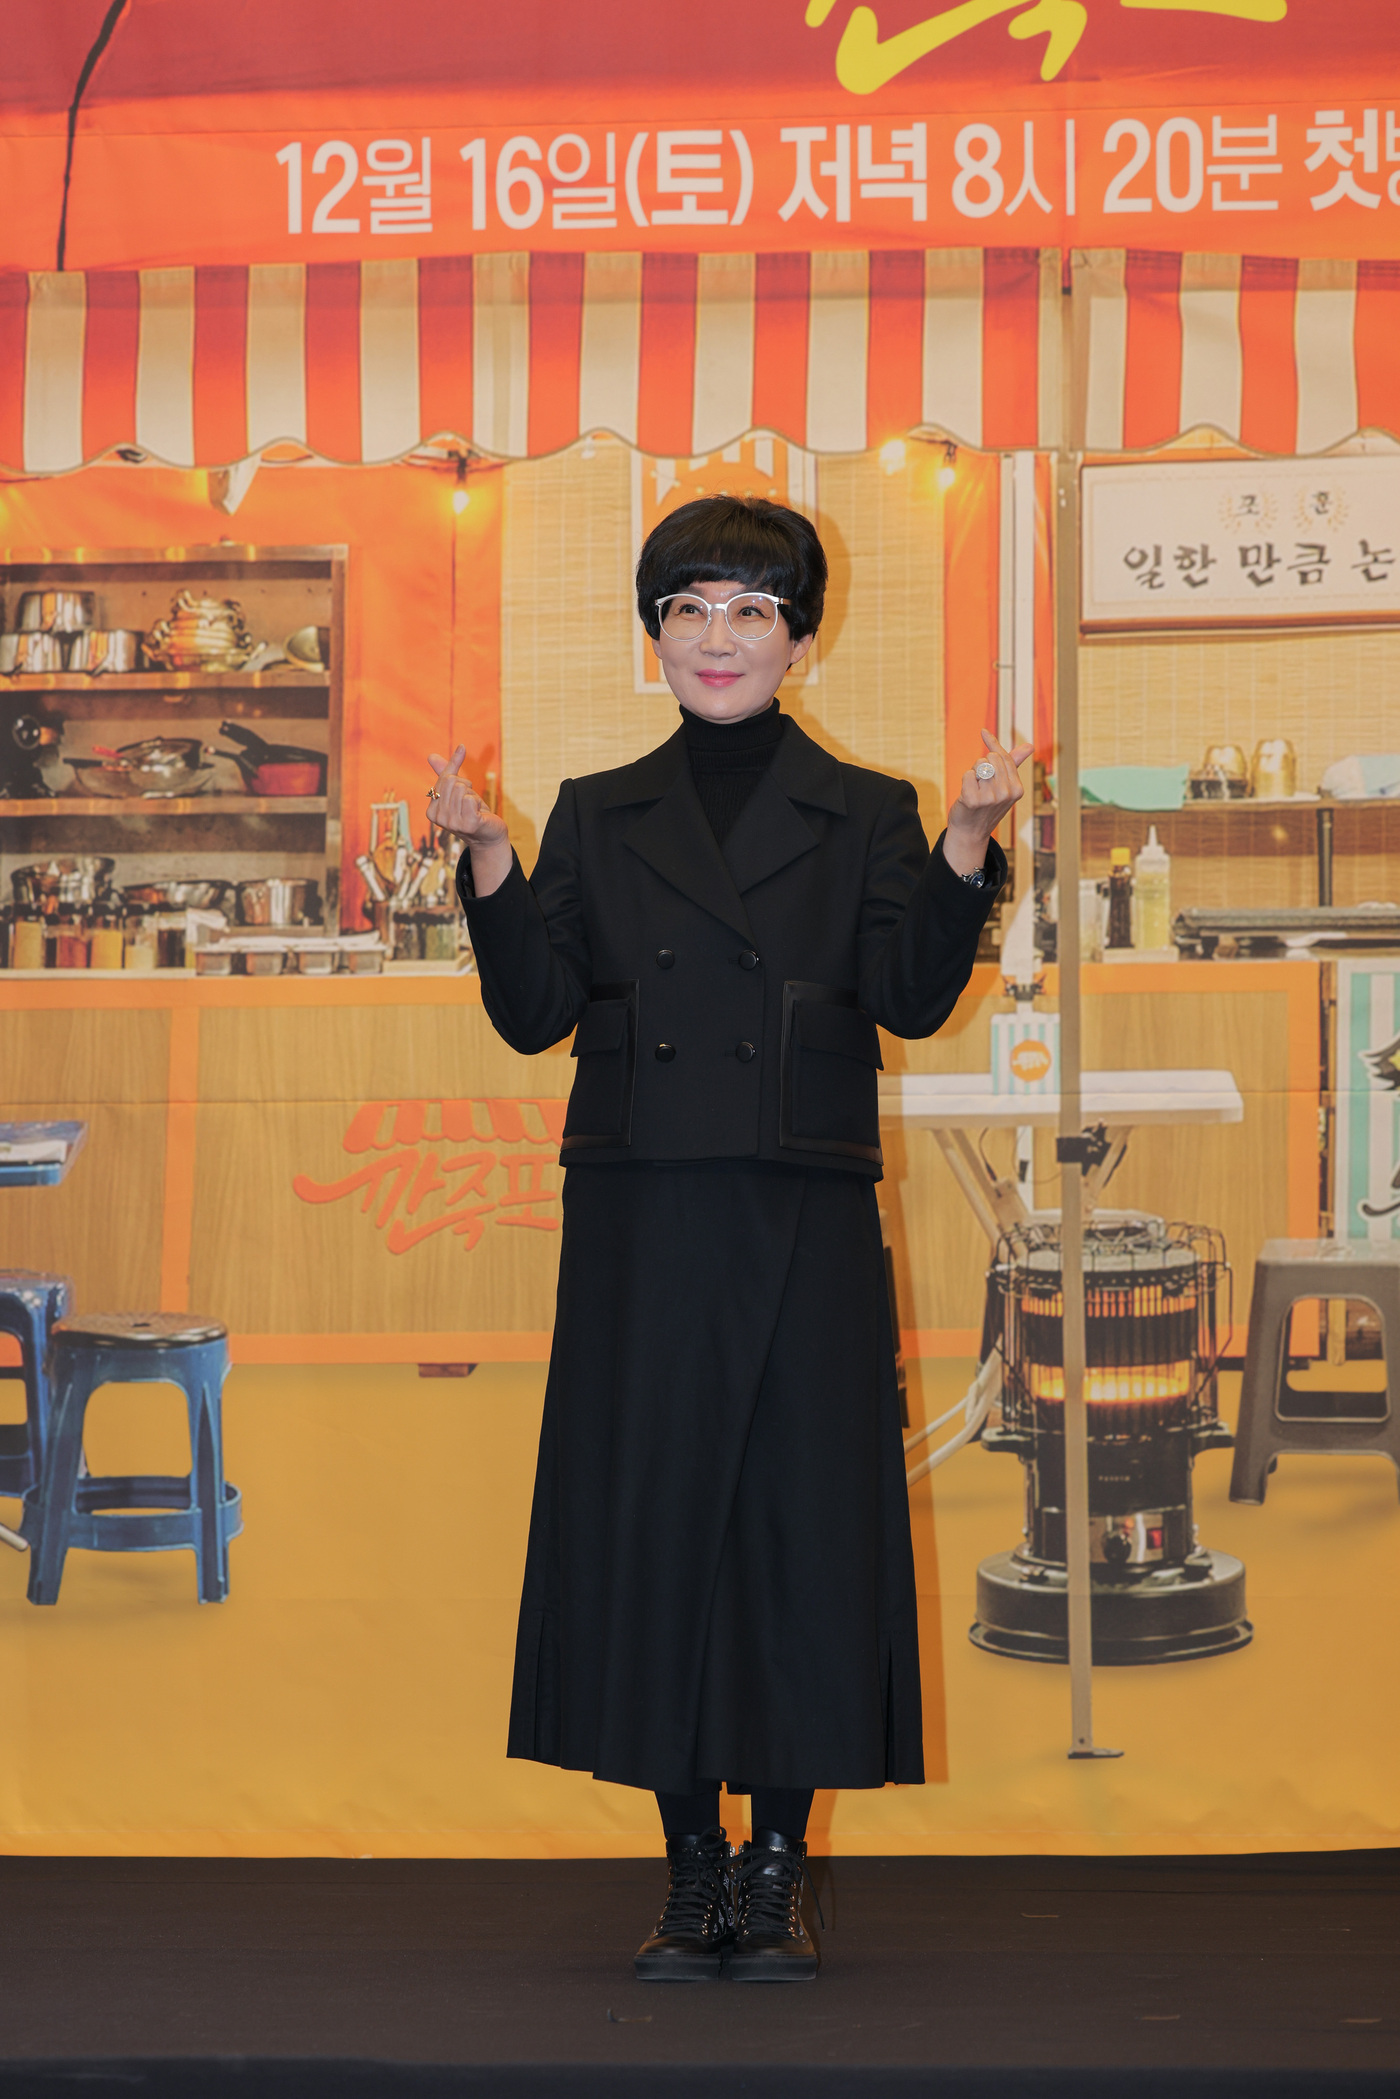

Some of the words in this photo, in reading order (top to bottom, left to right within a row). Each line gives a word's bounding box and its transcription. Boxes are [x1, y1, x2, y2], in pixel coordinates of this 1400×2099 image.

[275, 136, 433, 234] 12월
[778, 121, 928, 223] 저녁
[951, 118, 1077, 219] 8시
[1102, 113, 1283, 214] 20분
[1304, 108, 1400, 212] 첫
[1123, 543, 1217, 590] 일한
[1238, 542, 1331, 587] 만큼
